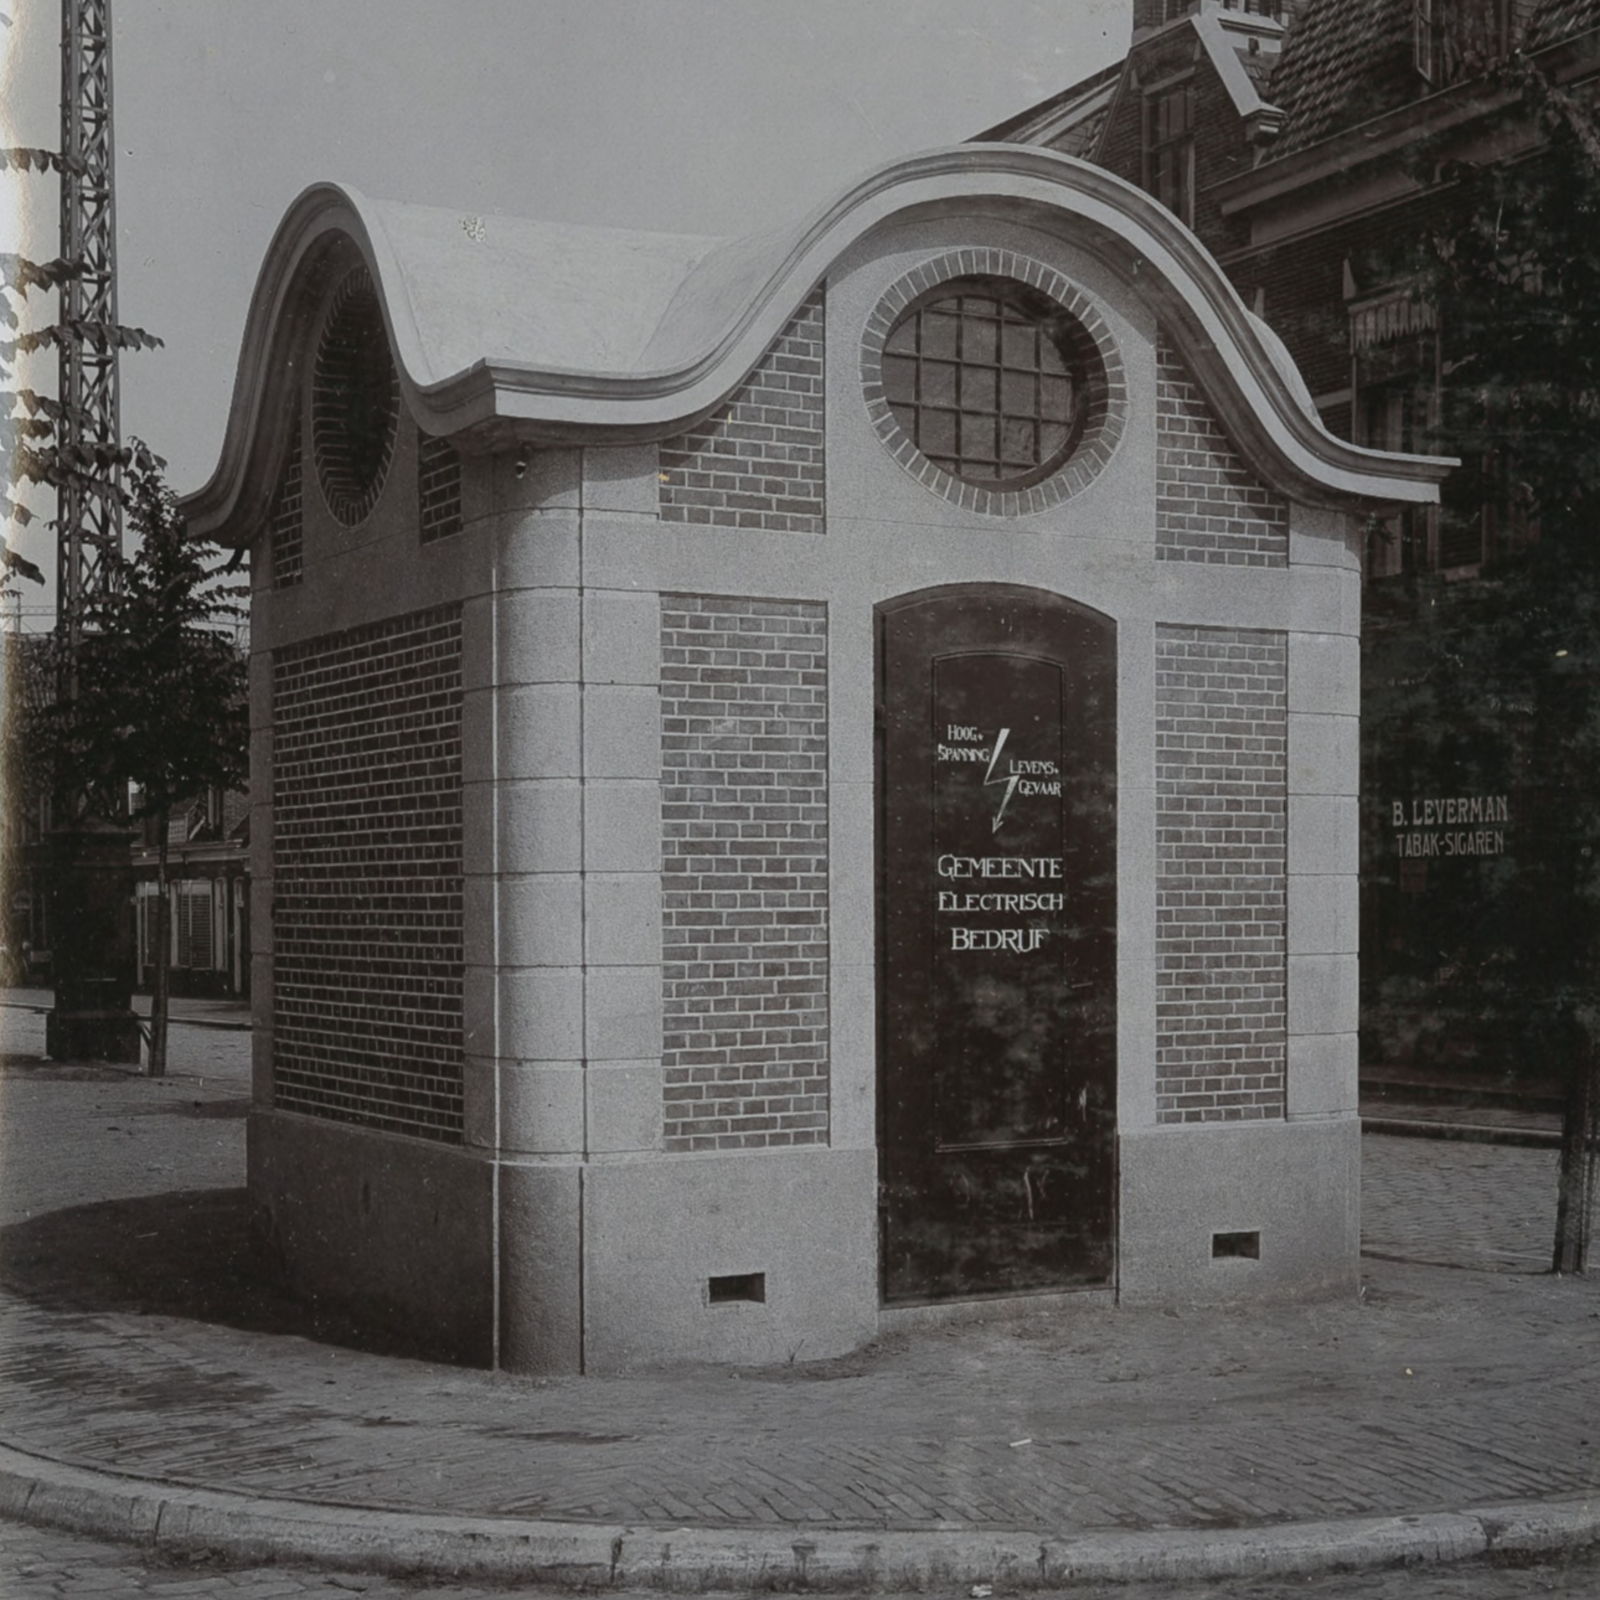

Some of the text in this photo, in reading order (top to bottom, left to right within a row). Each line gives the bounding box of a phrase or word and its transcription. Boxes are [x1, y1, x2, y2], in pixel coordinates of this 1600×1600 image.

[938, 743, 991, 763] SPANNING
[1018, 779, 1062, 797] GEVAAR
[1392, 796, 1508, 826] B. LEVERMAN
[1396, 831, 1504, 857] TABAK-SIGAREN
[938, 854, 1063, 881] GEMEENTE
[938, 891, 1063, 914] ELECTRISCH
